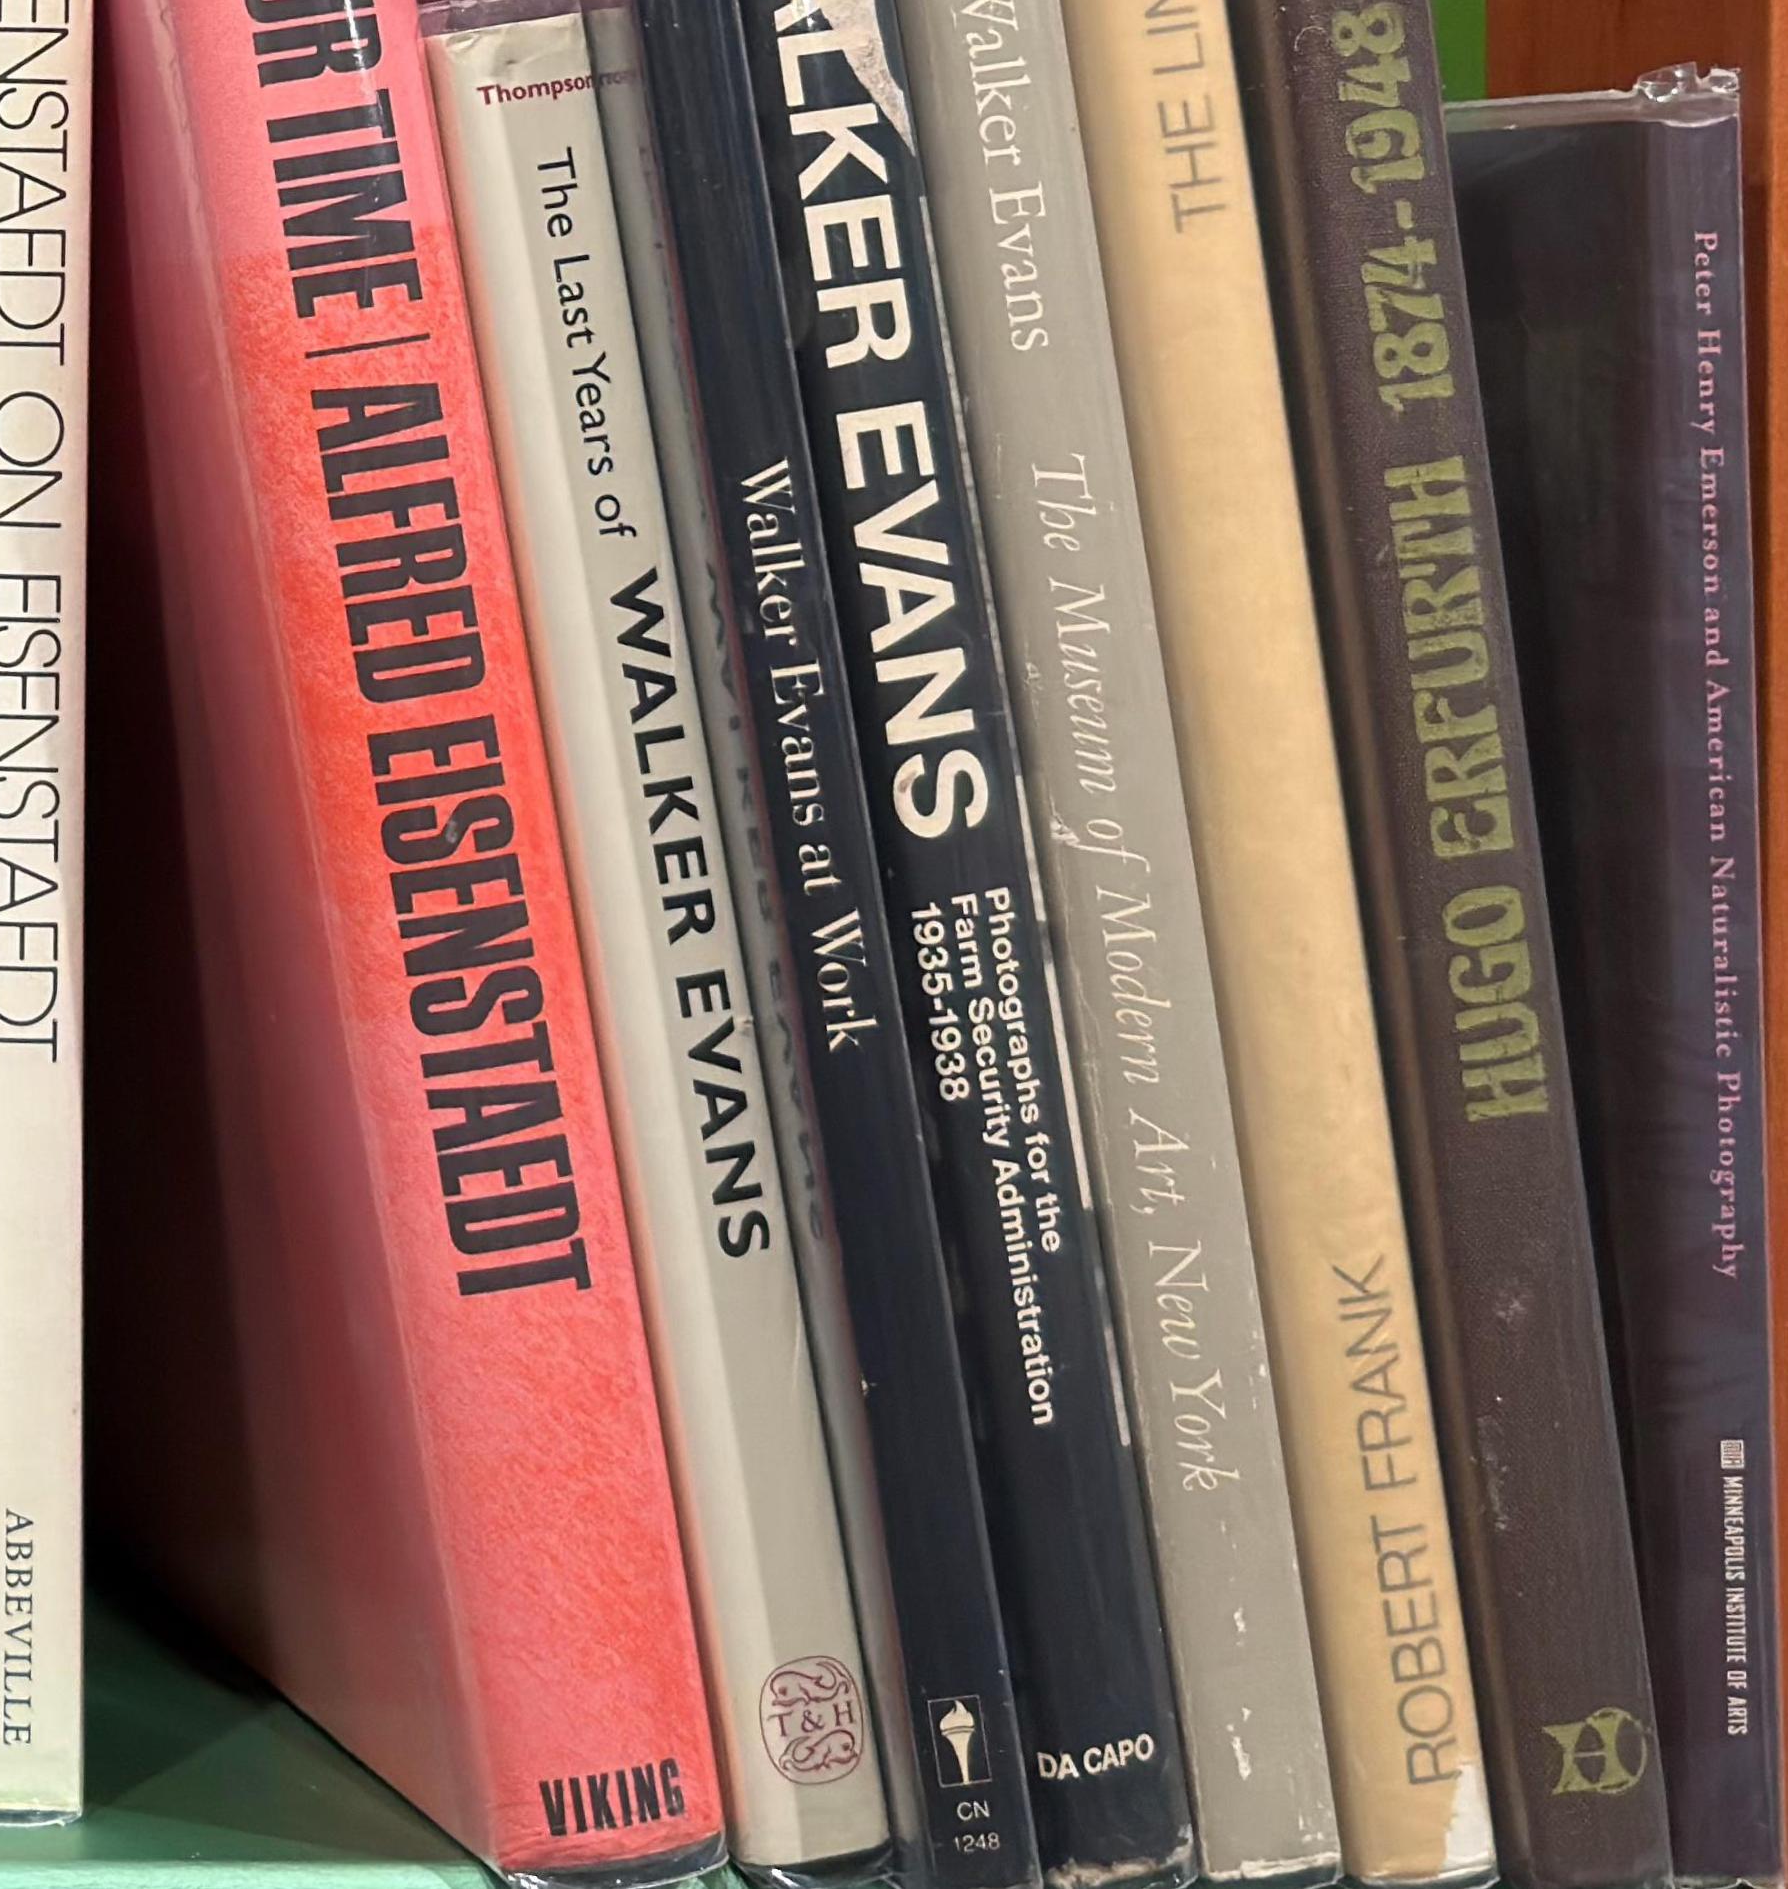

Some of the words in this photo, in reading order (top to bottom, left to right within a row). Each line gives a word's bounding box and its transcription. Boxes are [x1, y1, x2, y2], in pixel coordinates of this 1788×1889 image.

[477, 72, 594, 105] Thompson
[264, 88, 423, 319] TIME
[1156, 102, 1231, 233] THE
[1330, 2, 1460, 416] 1874-1948
[985, 184, 1054, 351] Evans
[1693, 230, 1718, 317] Peter
[1691, 329, 1722, 436] Henry
[305, 387, 487, 705] ALFRED
[736, 459, 810, 650] Walker
[1699, 448, 1725, 594] Emerson
[836, 399, 990, 838] EVANS
[1380, 454, 1515, 854] ERFURTH
[1704, 607, 1729, 668] and
[770, 664, 832, 828] Evans
[1706, 679, 1733, 843] American
[796, 844, 848, 895] at
[949, 893, 987, 984] Farm
[365, 714, 594, 1297] EISENSTAEDT
[807, 908, 875, 1053] Work
[908, 900, 970, 1100] 1935-1938
[985, 886, 1051, 1119] Photographs
[1437, 886, 1550, 1122] HUGO
[1711, 856, 1738, 1058] Naturalistic
[965, 998, 1022, 1144] Security
[1018, 1130, 1054, 1181] for
[1031, 1194, 1067, 1253] the
[1709, 1071, 1745, 1280] Photography
[992, 1154, 1062, 1424] Administration
[1331, 1252, 1422, 1491] FRANK
[1723, 1476, 1745, 1581] MINNEAPOLIS
[2, 1509, 34, 1745] ABBEVILLE
[1368, 1516, 1460, 1785] ROBERT
[1725, 1587, 1746, 1662] INSTITUTE
[1727, 1669, 1746, 1693] OF
[1037, 1751, 1079, 1779] DA
[1083, 1733, 1155, 1773] CAPO
[1727, 1697, 1747, 1736] ARTS
[537, 1757, 687, 1838] VIKING
[953, 1832, 1000, 1853] 1248
[956, 1801, 990, 1820] CN
